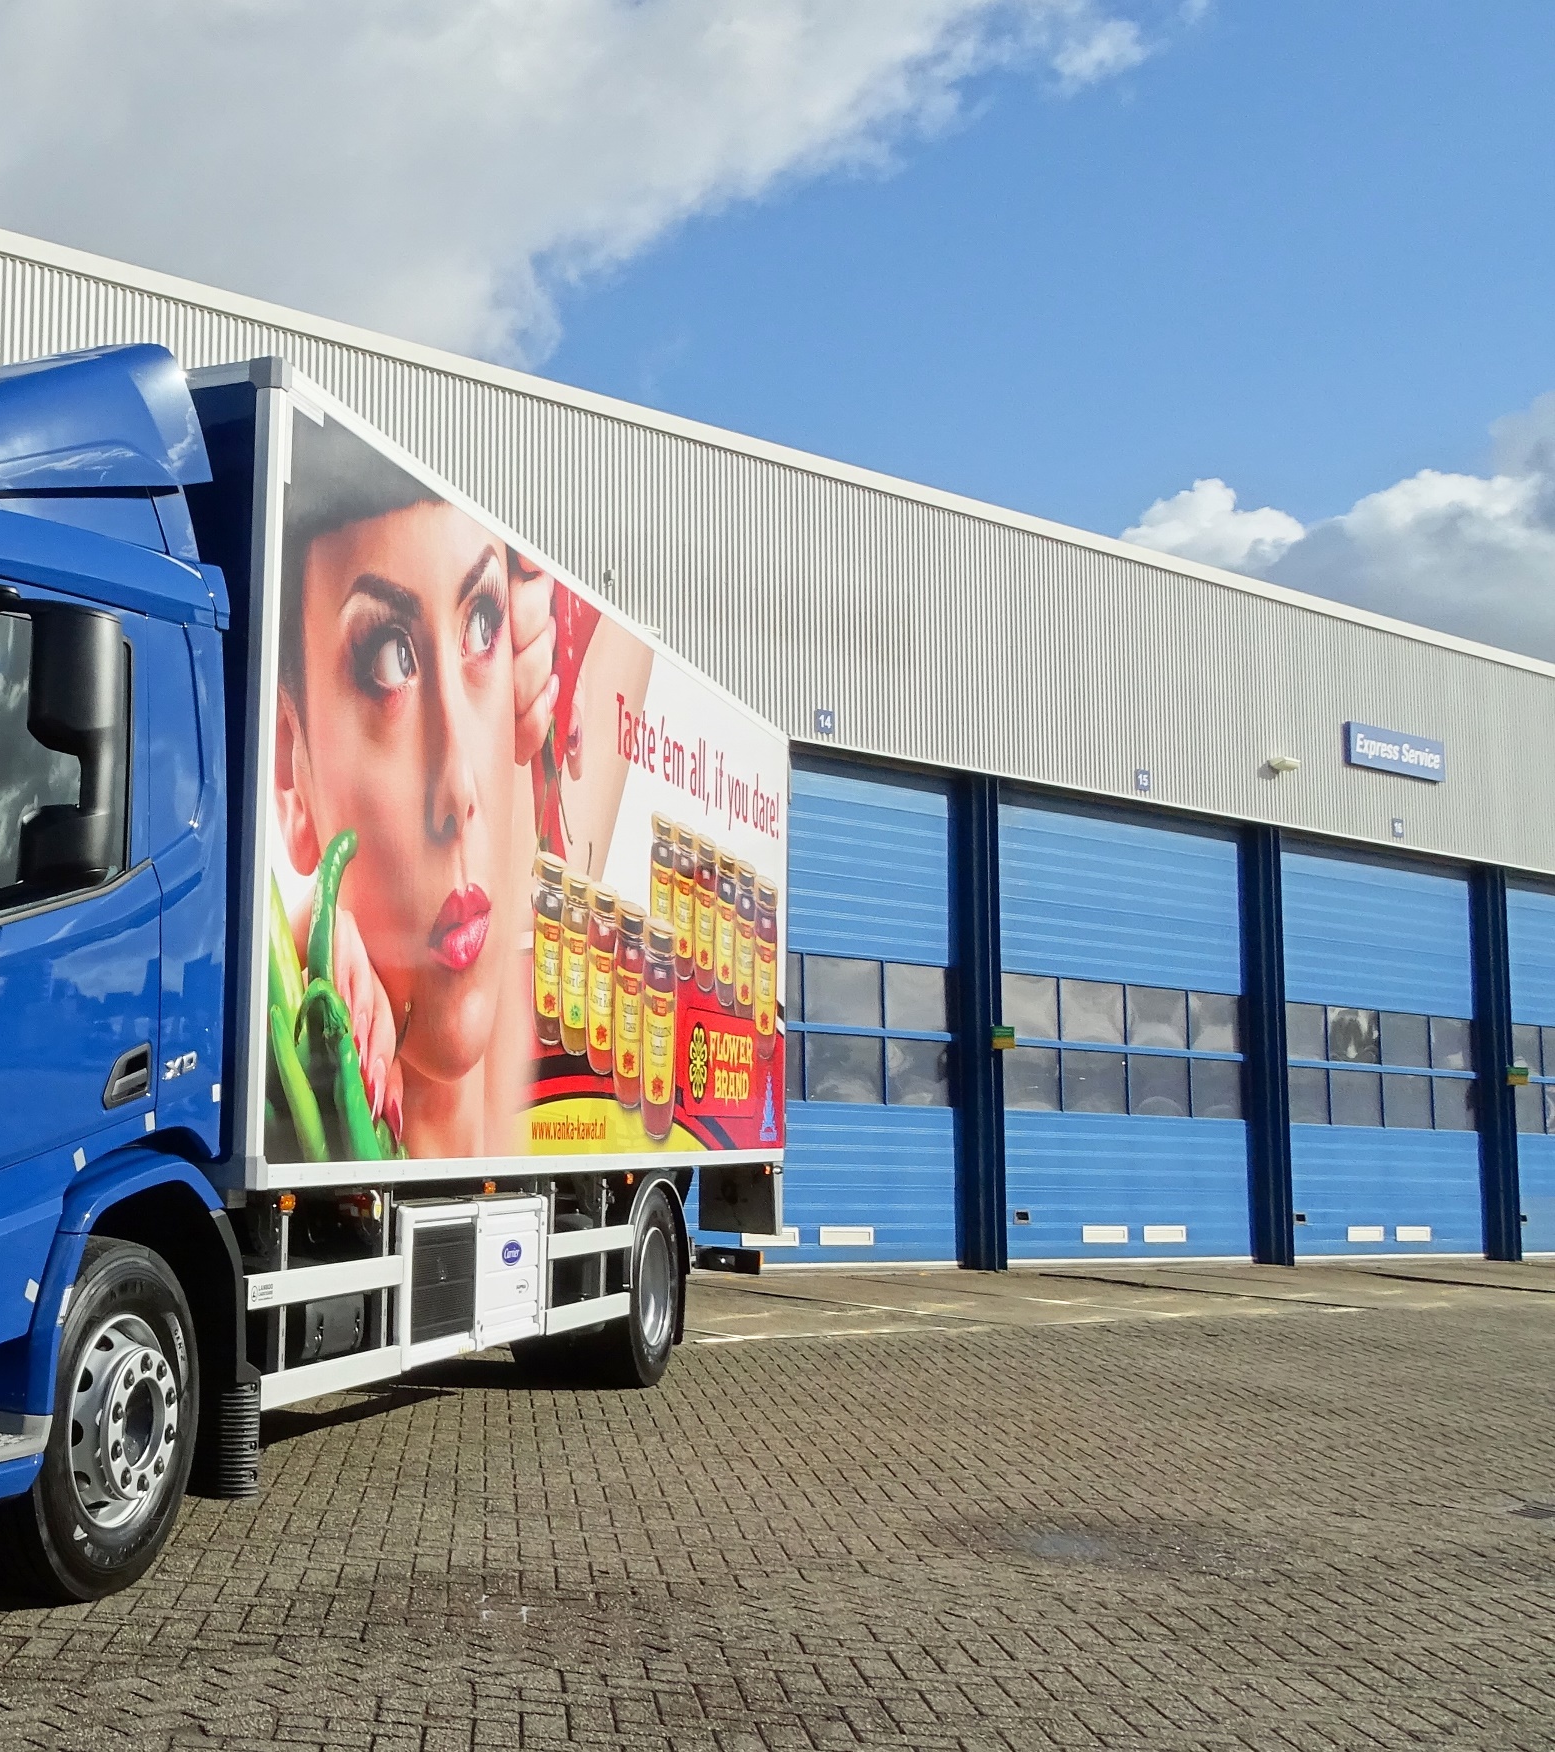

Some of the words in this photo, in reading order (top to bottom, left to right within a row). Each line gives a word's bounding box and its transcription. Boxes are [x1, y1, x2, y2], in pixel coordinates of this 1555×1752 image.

[819, 715, 831, 729] 14
[617, 692, 655, 773] Taste
[690, 737, 710, 816] all,
[715, 750, 724, 810] if
[728, 774, 748, 830] you
[752, 773, 779, 839] dare!
[1356, 733, 1400, 760] Express
[1401, 743, 1441, 769] Service
[1138, 774, 1149, 786] 15
[709, 1031, 754, 1071] FLOWER
[714, 1066, 750, 1107] BRAND
[532, 1115, 606, 1140] www.vanka-kawat.nl
